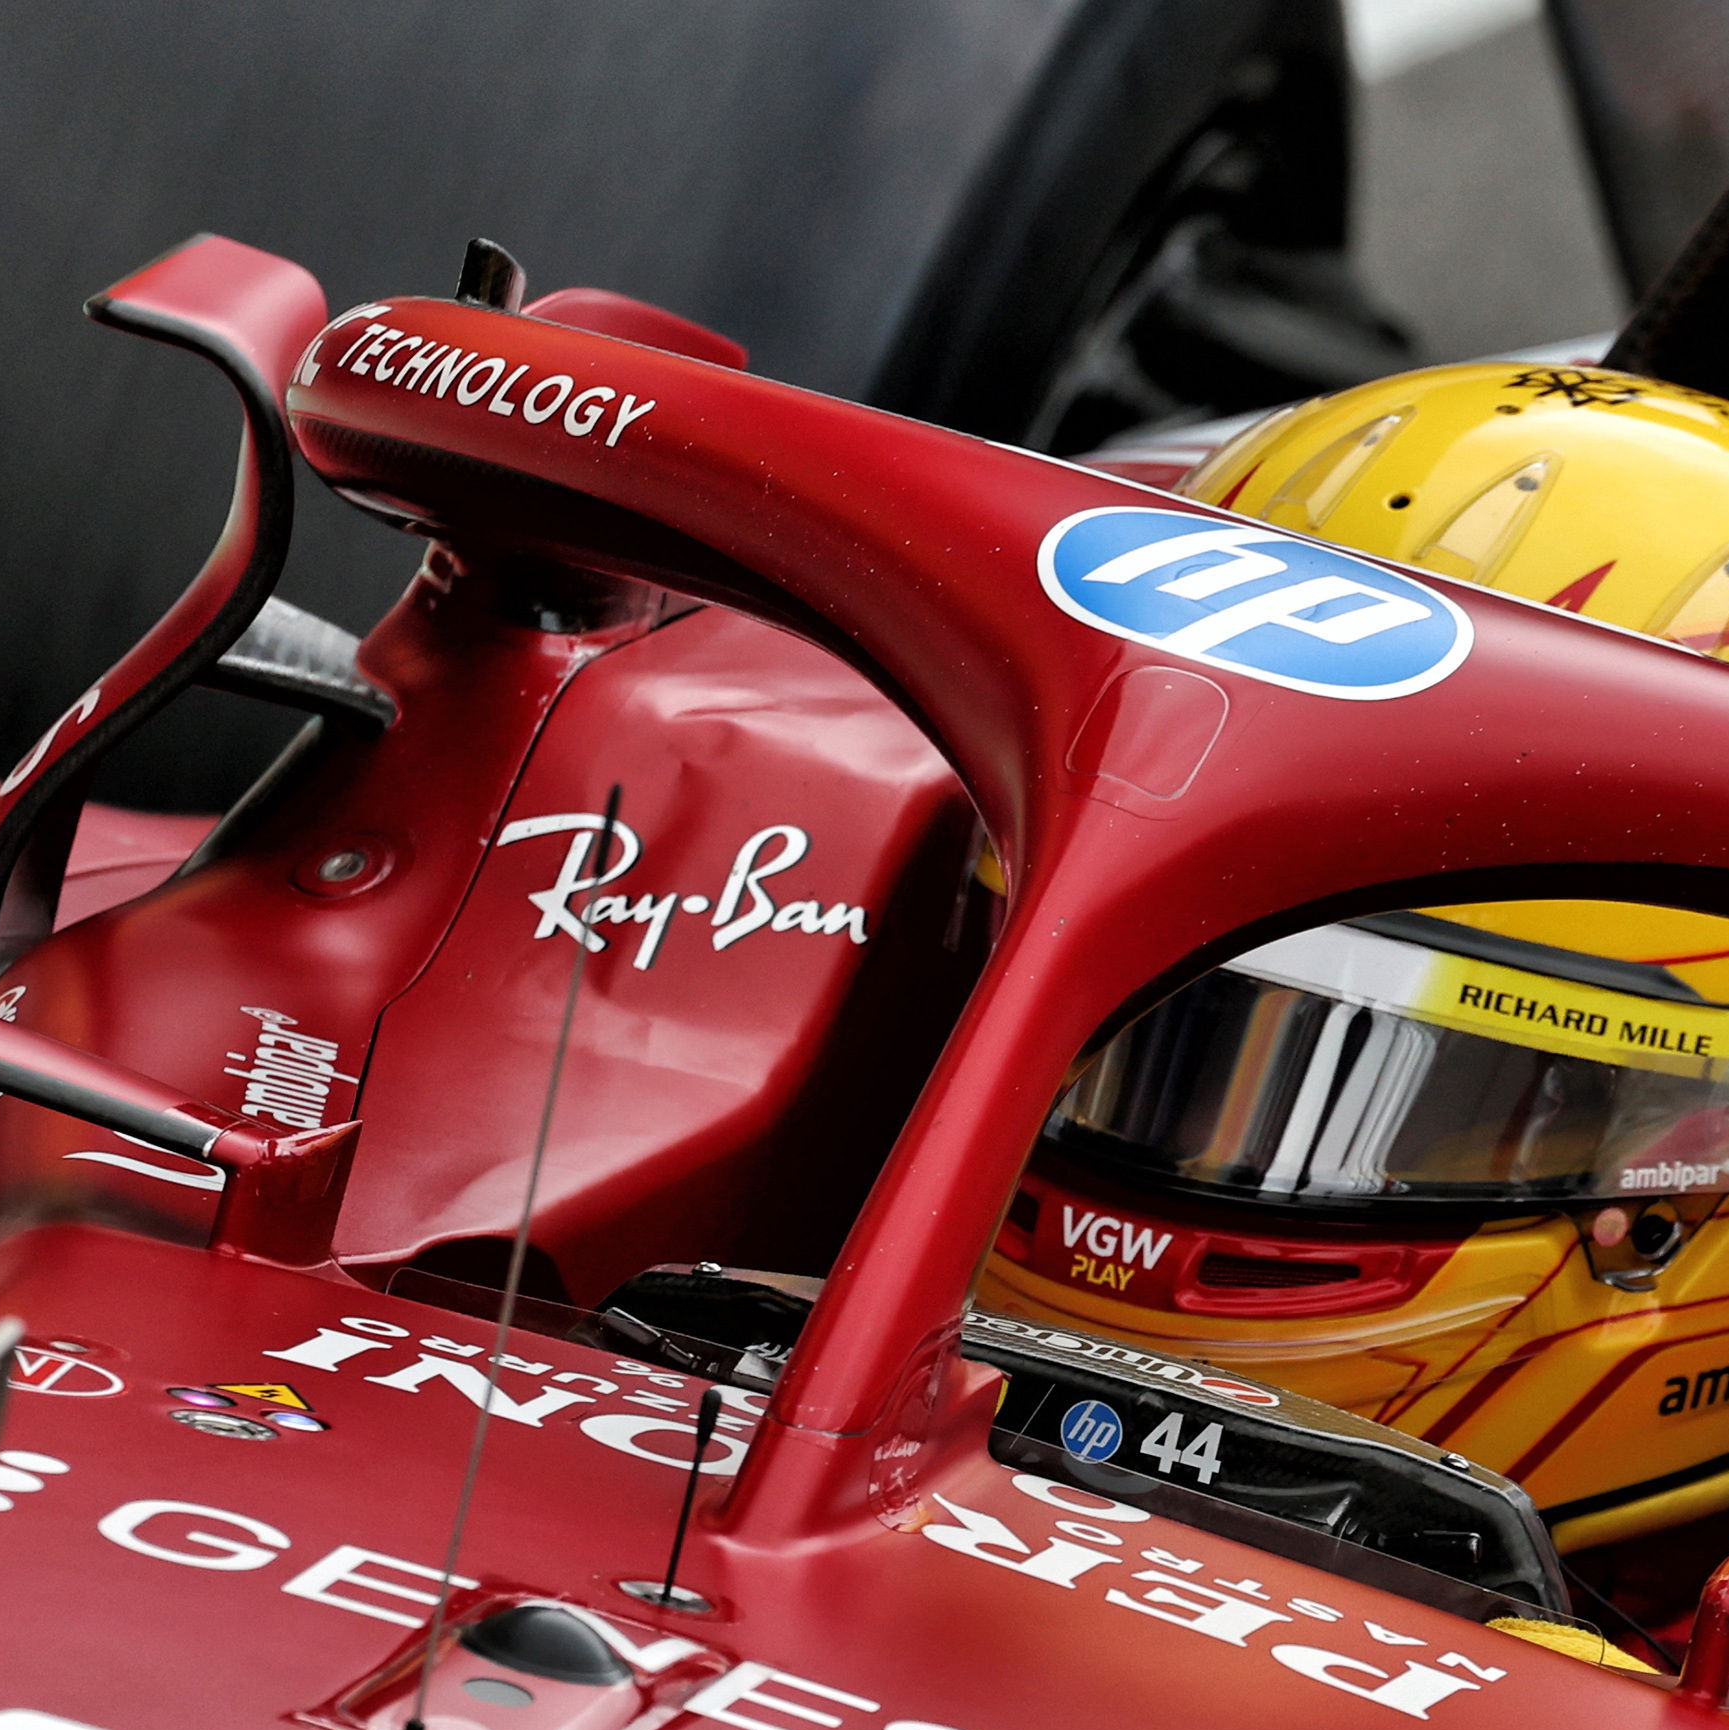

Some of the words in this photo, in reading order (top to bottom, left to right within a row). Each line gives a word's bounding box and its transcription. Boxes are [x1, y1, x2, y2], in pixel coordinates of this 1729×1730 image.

[336, 321, 657, 450] TECHNOLOGY
[1458, 983, 1610, 1038] RICHARD
[1619, 1020, 1713, 1058] MILLE
[1620, 1161, 1724, 1192] ambipar
[1063, 1205, 1173, 1271] VGW
[1071, 1254, 1135, 1291] PLAY
[339, 1316, 757, 1432] ZZURRO
[1140, 1411, 1225, 1485] 44
[1054, 1520, 1508, 1683] NASTRO
